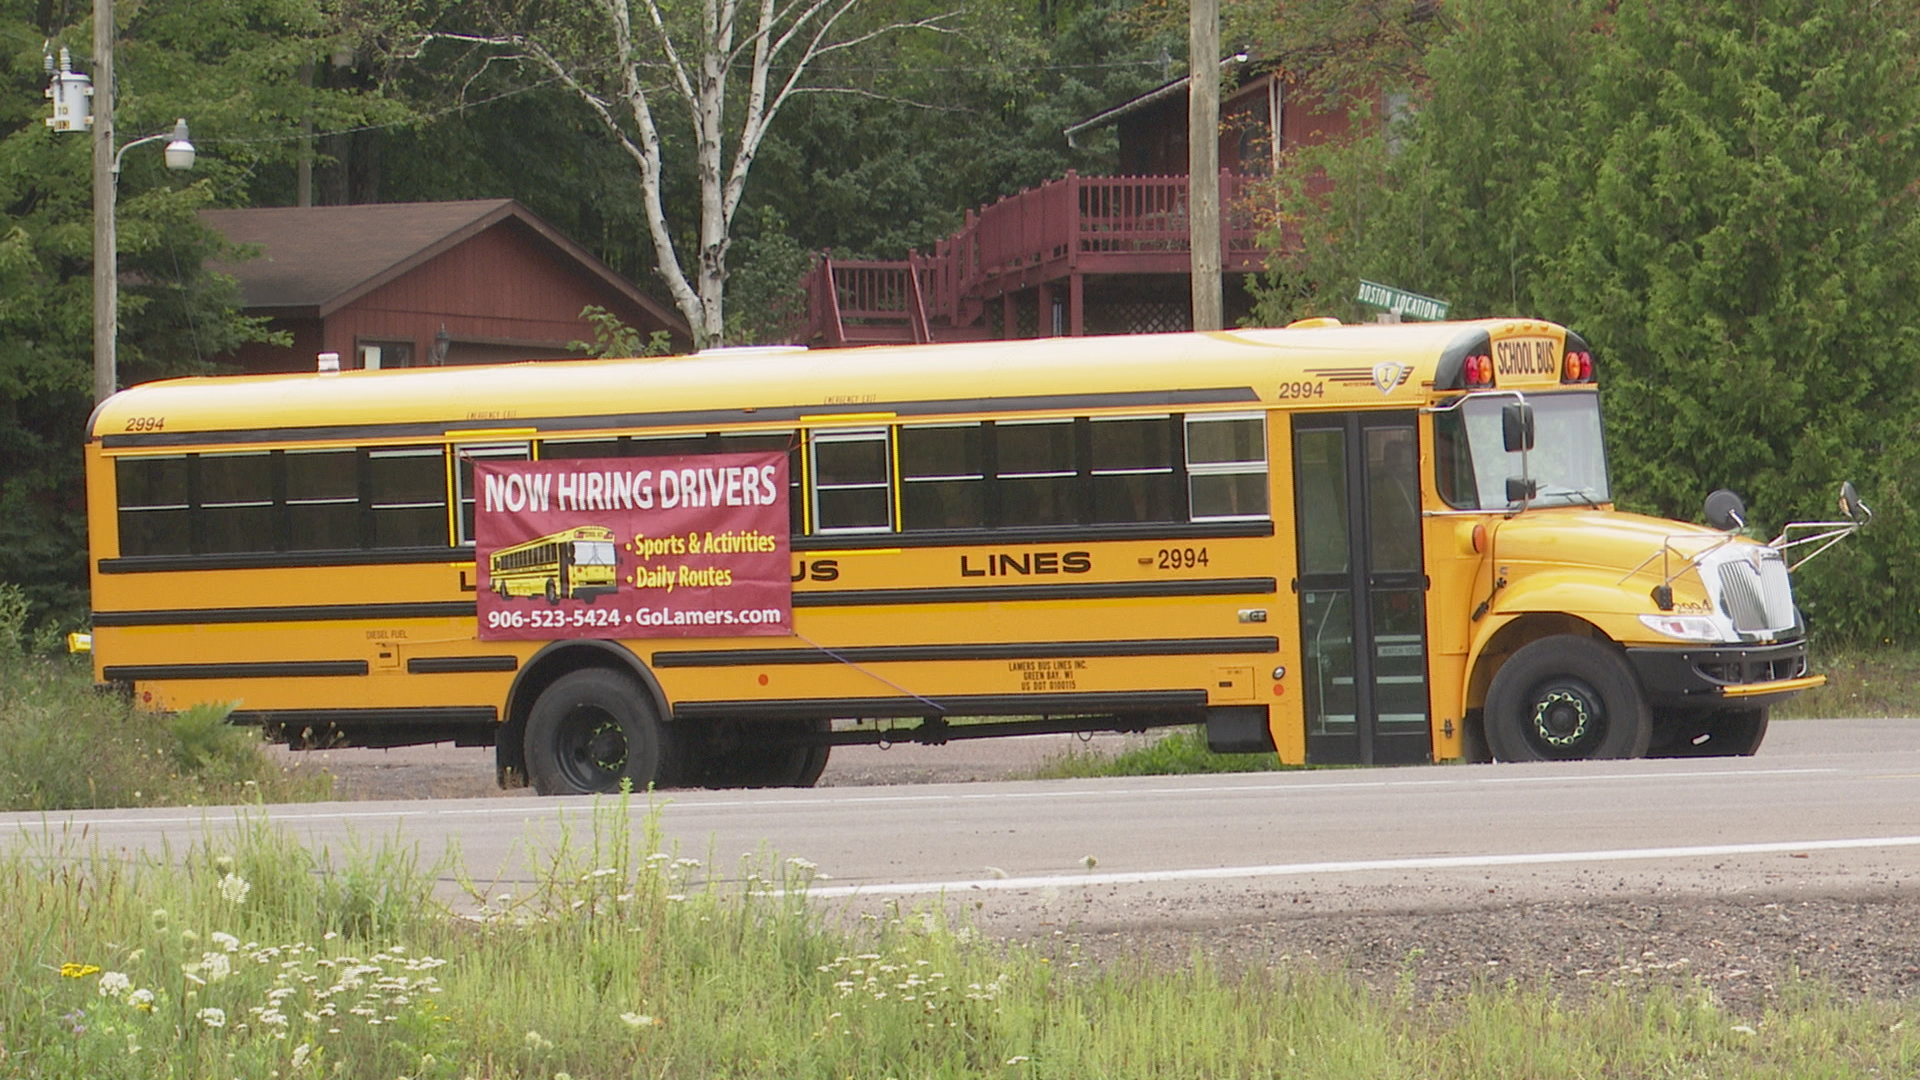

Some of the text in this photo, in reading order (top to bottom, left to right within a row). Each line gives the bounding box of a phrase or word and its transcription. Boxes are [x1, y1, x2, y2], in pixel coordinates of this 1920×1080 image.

[1358, 283, 1393, 308] BOSTON
[1394, 293, 1439, 320] LOCATION
[1497, 341, 1555, 375] SCHOOL BUS
[1279, 381, 1325, 400] 2994
[125, 417, 165, 432] 2994
[485, 465, 777, 512] NOW HIRING DRIVERS
[635, 532, 776, 559] Sports & Activities
[790, 551, 1092, 582] US LINES
[1158, 548, 1209, 570] 2994
[636, 566, 732, 592] Daily Routes
[488, 606, 782, 629] 906-523-5424 GoLamers.com
[366, 629, 408, 639] DIESEL FUEL
[1008, 660, 1088, 672] LAMERS BUS LINES INC.
[1023, 671, 1045, 681] GREEN
[1064, 670, 1074, 679] WI
[1021, 681, 1030, 691] US
[1033, 681, 1047, 691] DOT
